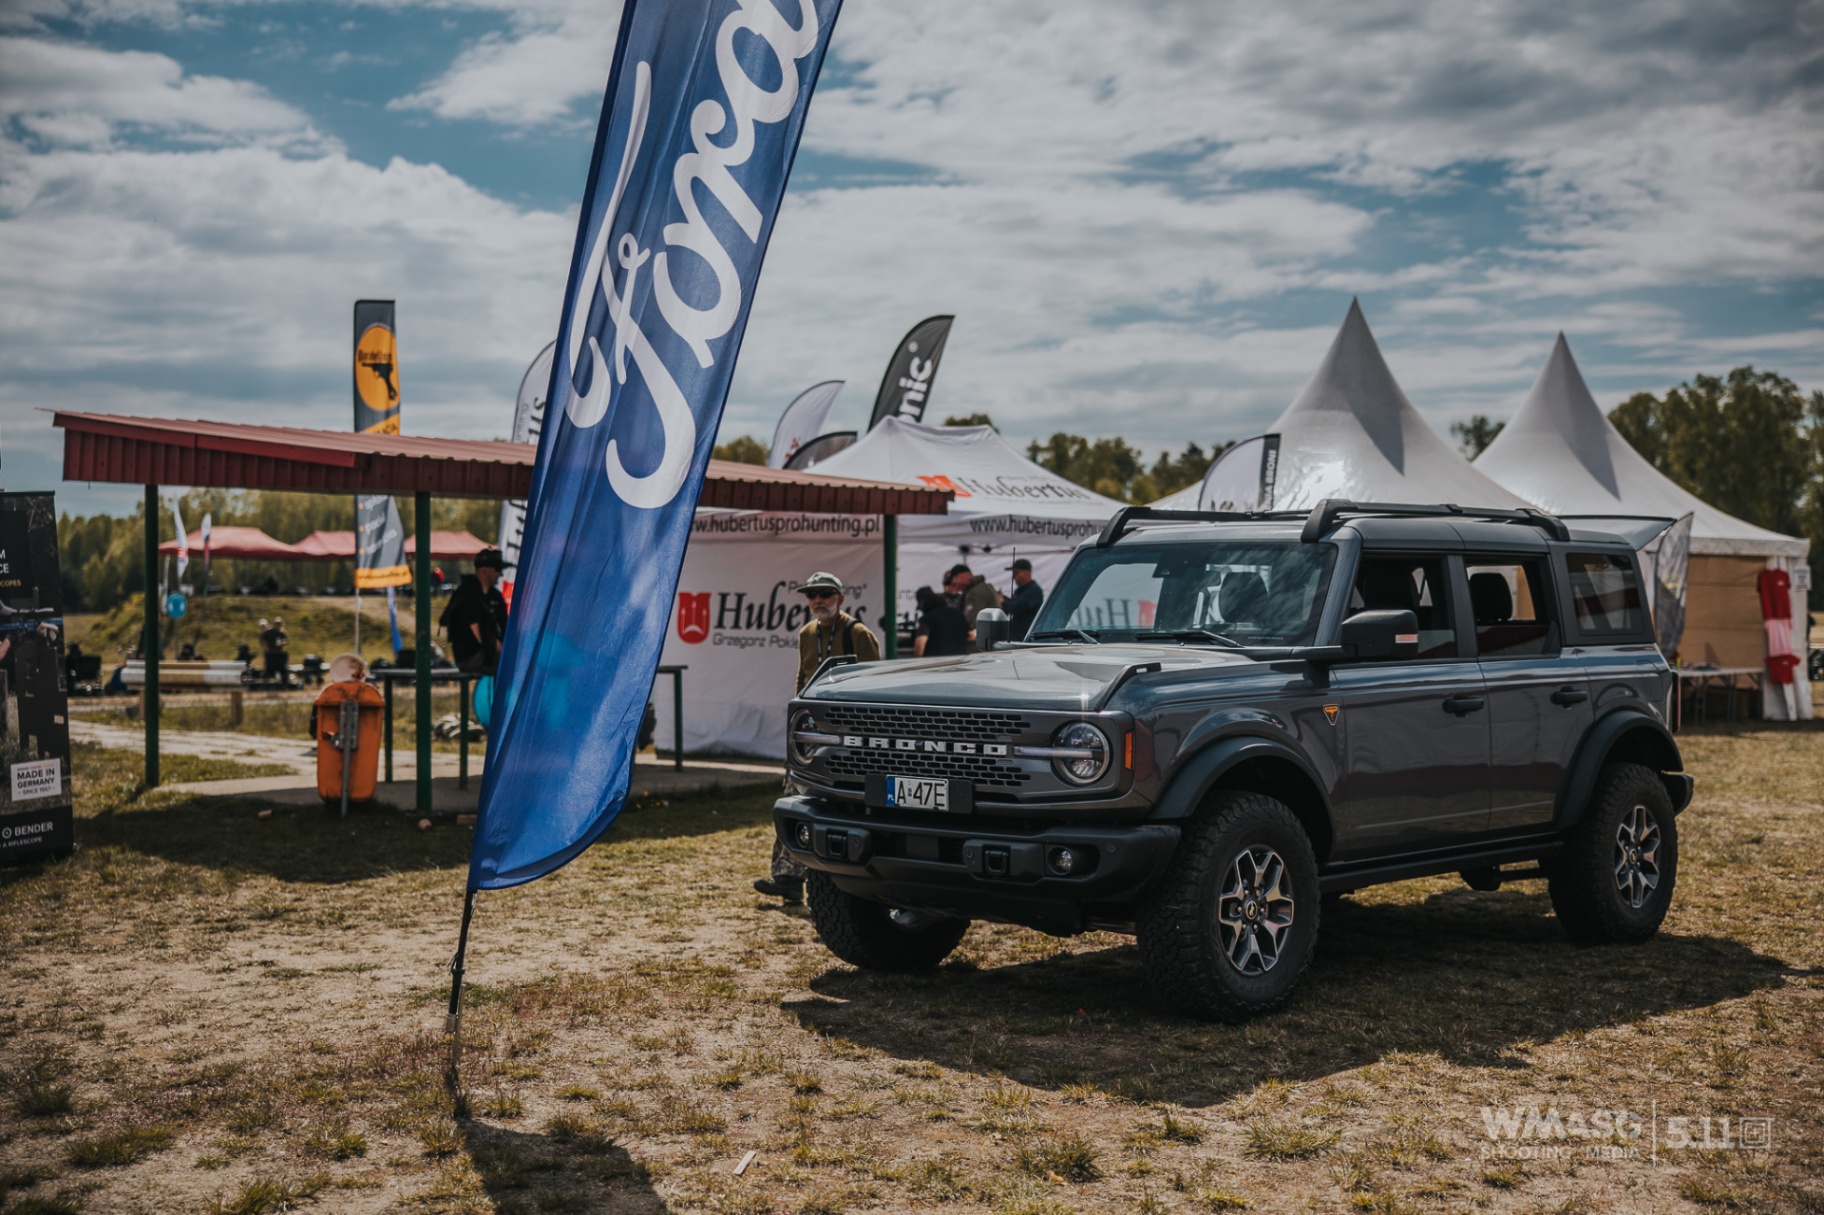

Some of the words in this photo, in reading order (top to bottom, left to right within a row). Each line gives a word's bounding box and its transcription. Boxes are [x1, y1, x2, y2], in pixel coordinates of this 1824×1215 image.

[713, 632, 767, 650] Grzegorz
[843, 735, 1008, 757] BRONCO
[17, 769, 43, 781] MADE
[45, 768, 55, 777] IN
[17, 777, 55, 789] GERMANY
[912, 782, 946, 807] 47E
[14, 821, 54, 836] BENDER
[8, 836, 43, 847] RIFLESCOPE
